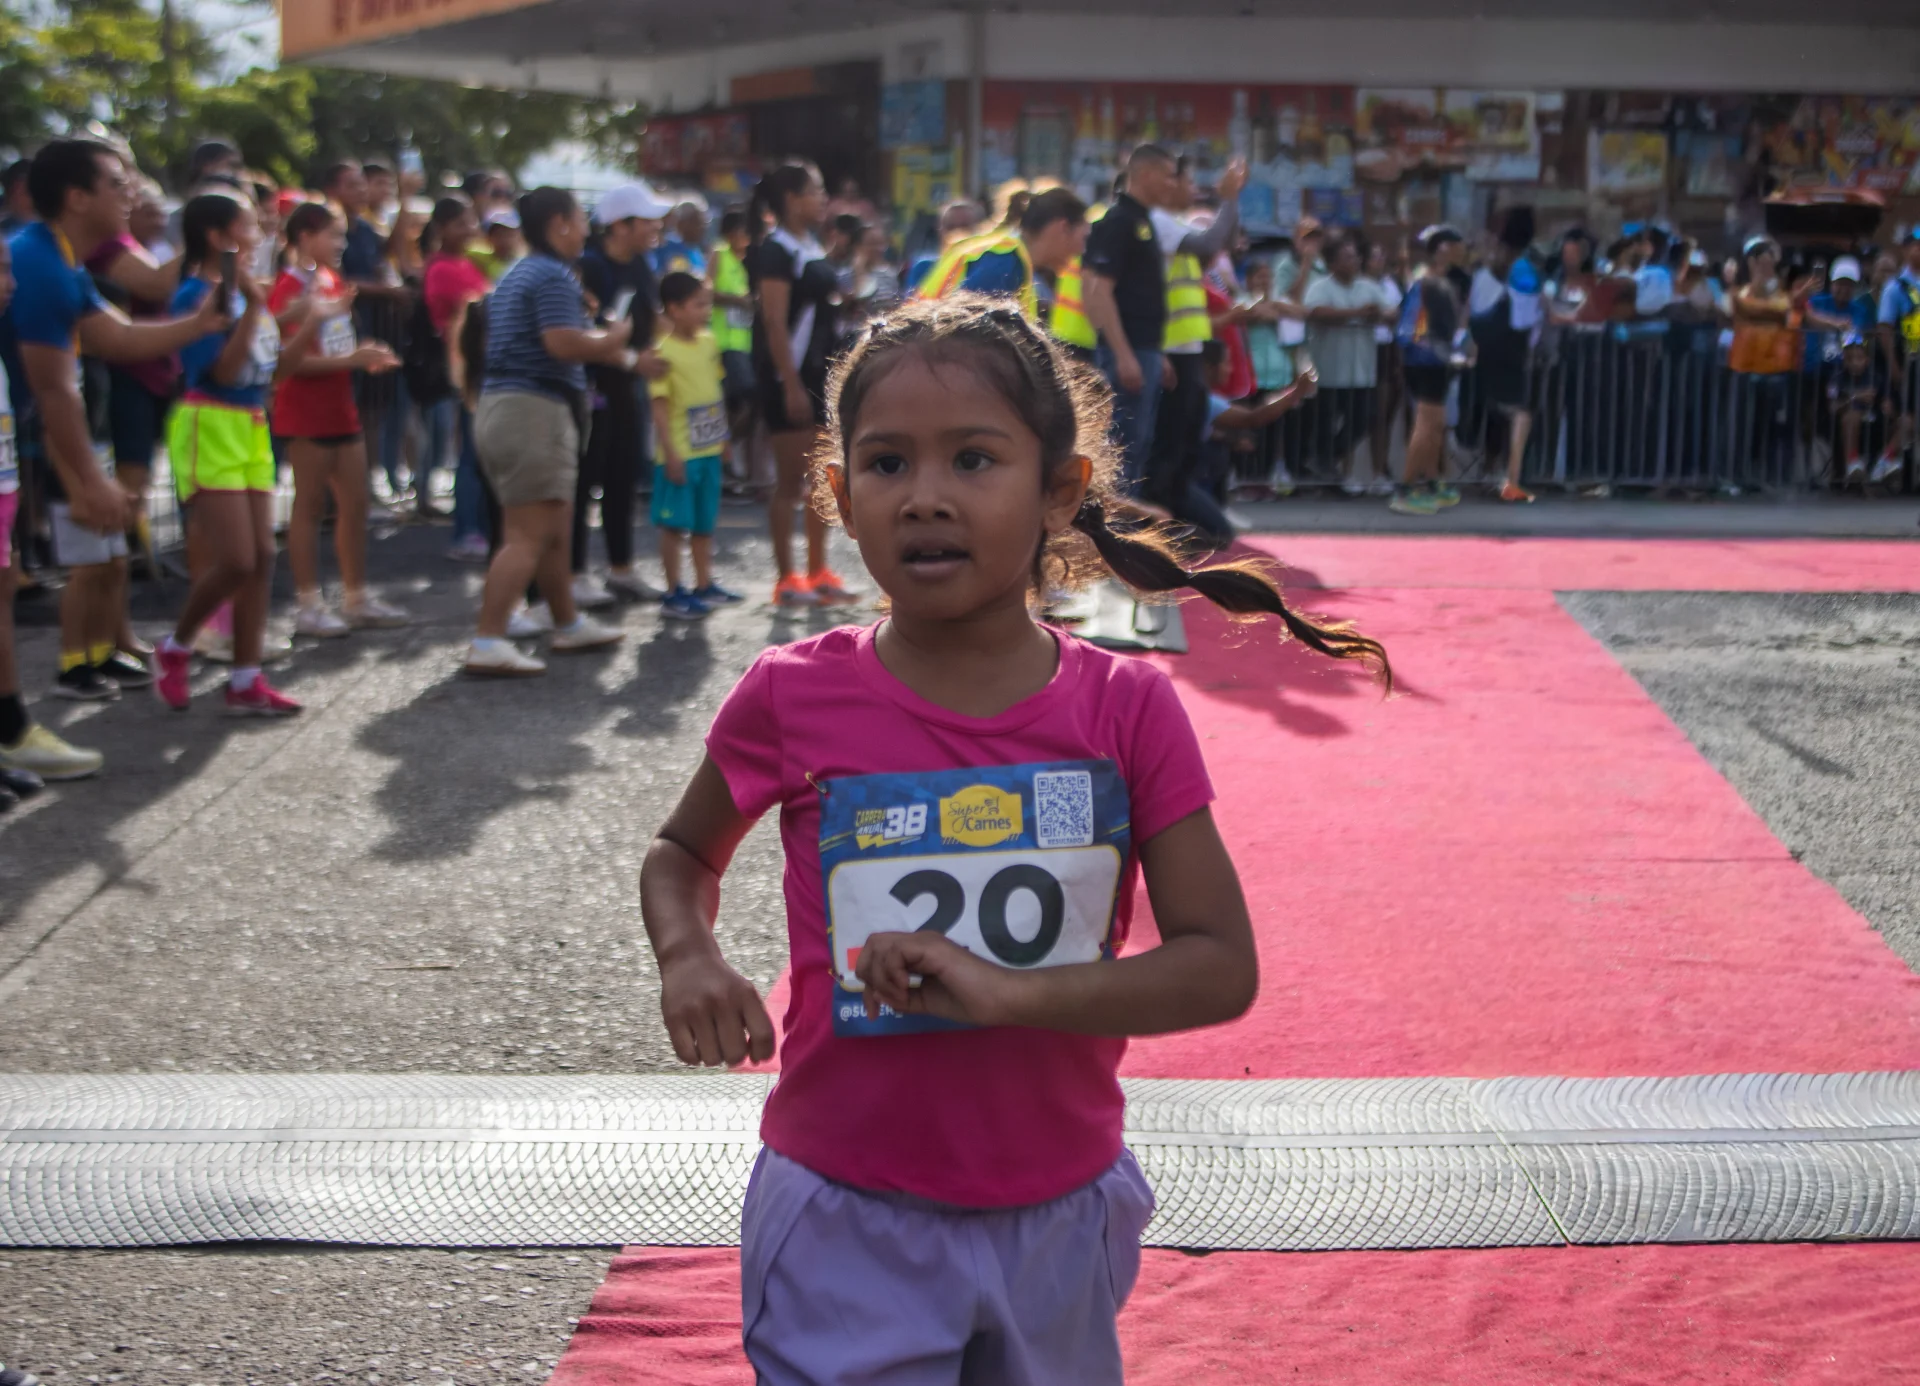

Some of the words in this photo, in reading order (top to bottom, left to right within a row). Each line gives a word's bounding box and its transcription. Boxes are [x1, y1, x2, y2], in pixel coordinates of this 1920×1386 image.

[856, 822, 884, 836] ANUAL
[884, 804, 928, 839] 38
[947, 802, 985, 834] Super
[965, 816, 1012, 832] Carnes
[1047, 837, 1086, 845] RESULTADOS
[889, 863, 1065, 968] 20
